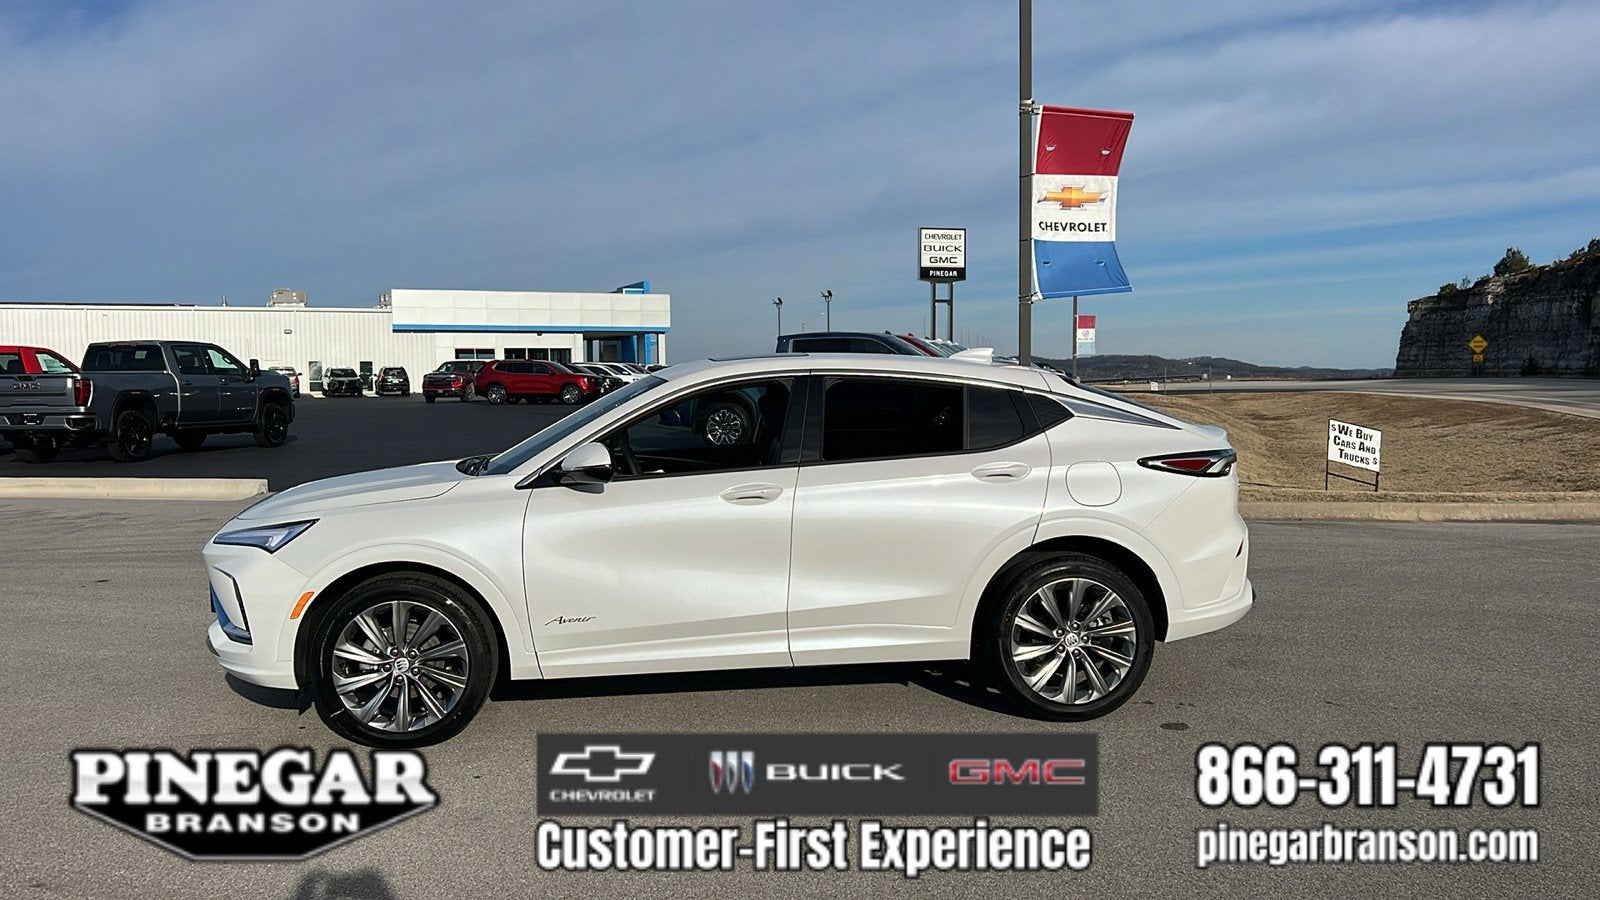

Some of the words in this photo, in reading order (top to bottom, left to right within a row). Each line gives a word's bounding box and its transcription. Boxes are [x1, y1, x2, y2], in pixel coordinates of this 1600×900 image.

[1039, 221, 1107, 232] CHEVROLET
[923, 244, 963, 252] BUICK
[929, 256, 958, 264] GMC
[545, 616, 596, 626] Avenir
